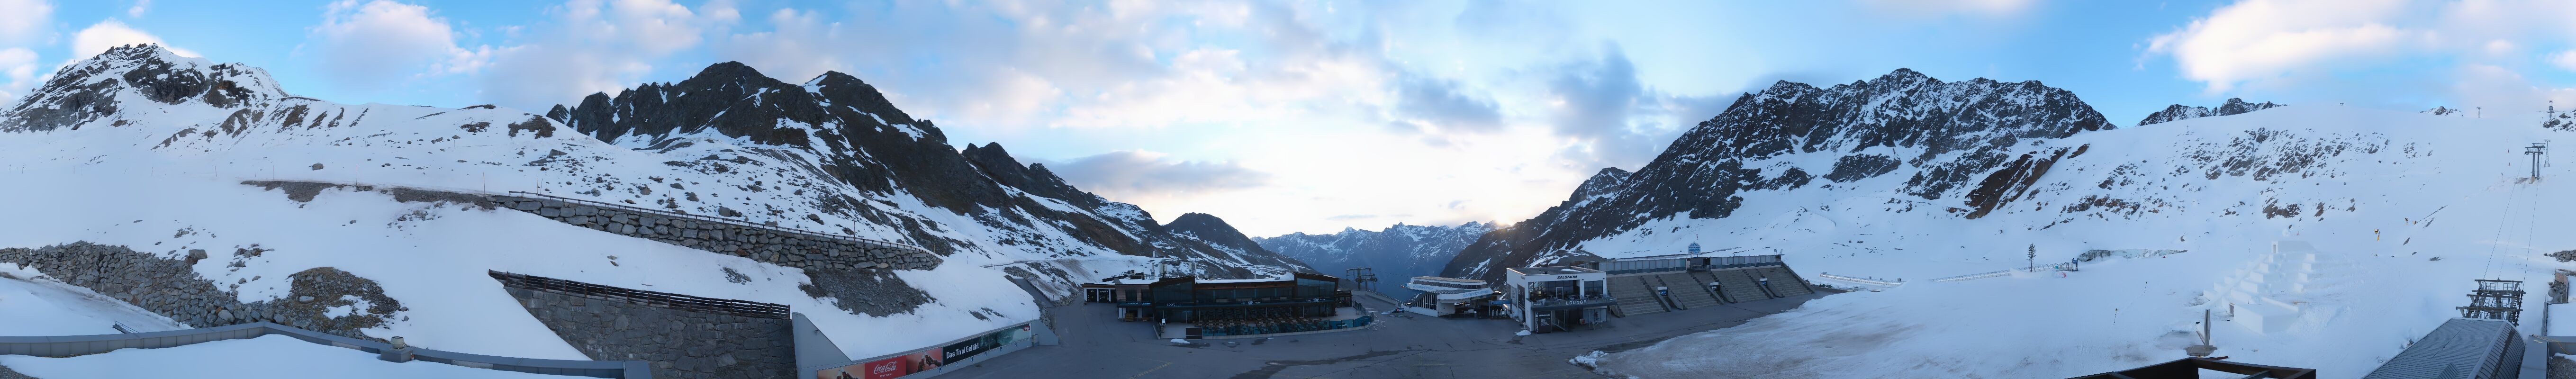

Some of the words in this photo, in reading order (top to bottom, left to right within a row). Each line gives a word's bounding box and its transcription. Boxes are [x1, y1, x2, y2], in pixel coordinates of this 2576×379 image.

[955, 346, 966, 356] Tirol
[966, 343, 979, 352] Gefühl
[874, 361, 898, 375] Coca-Cola
